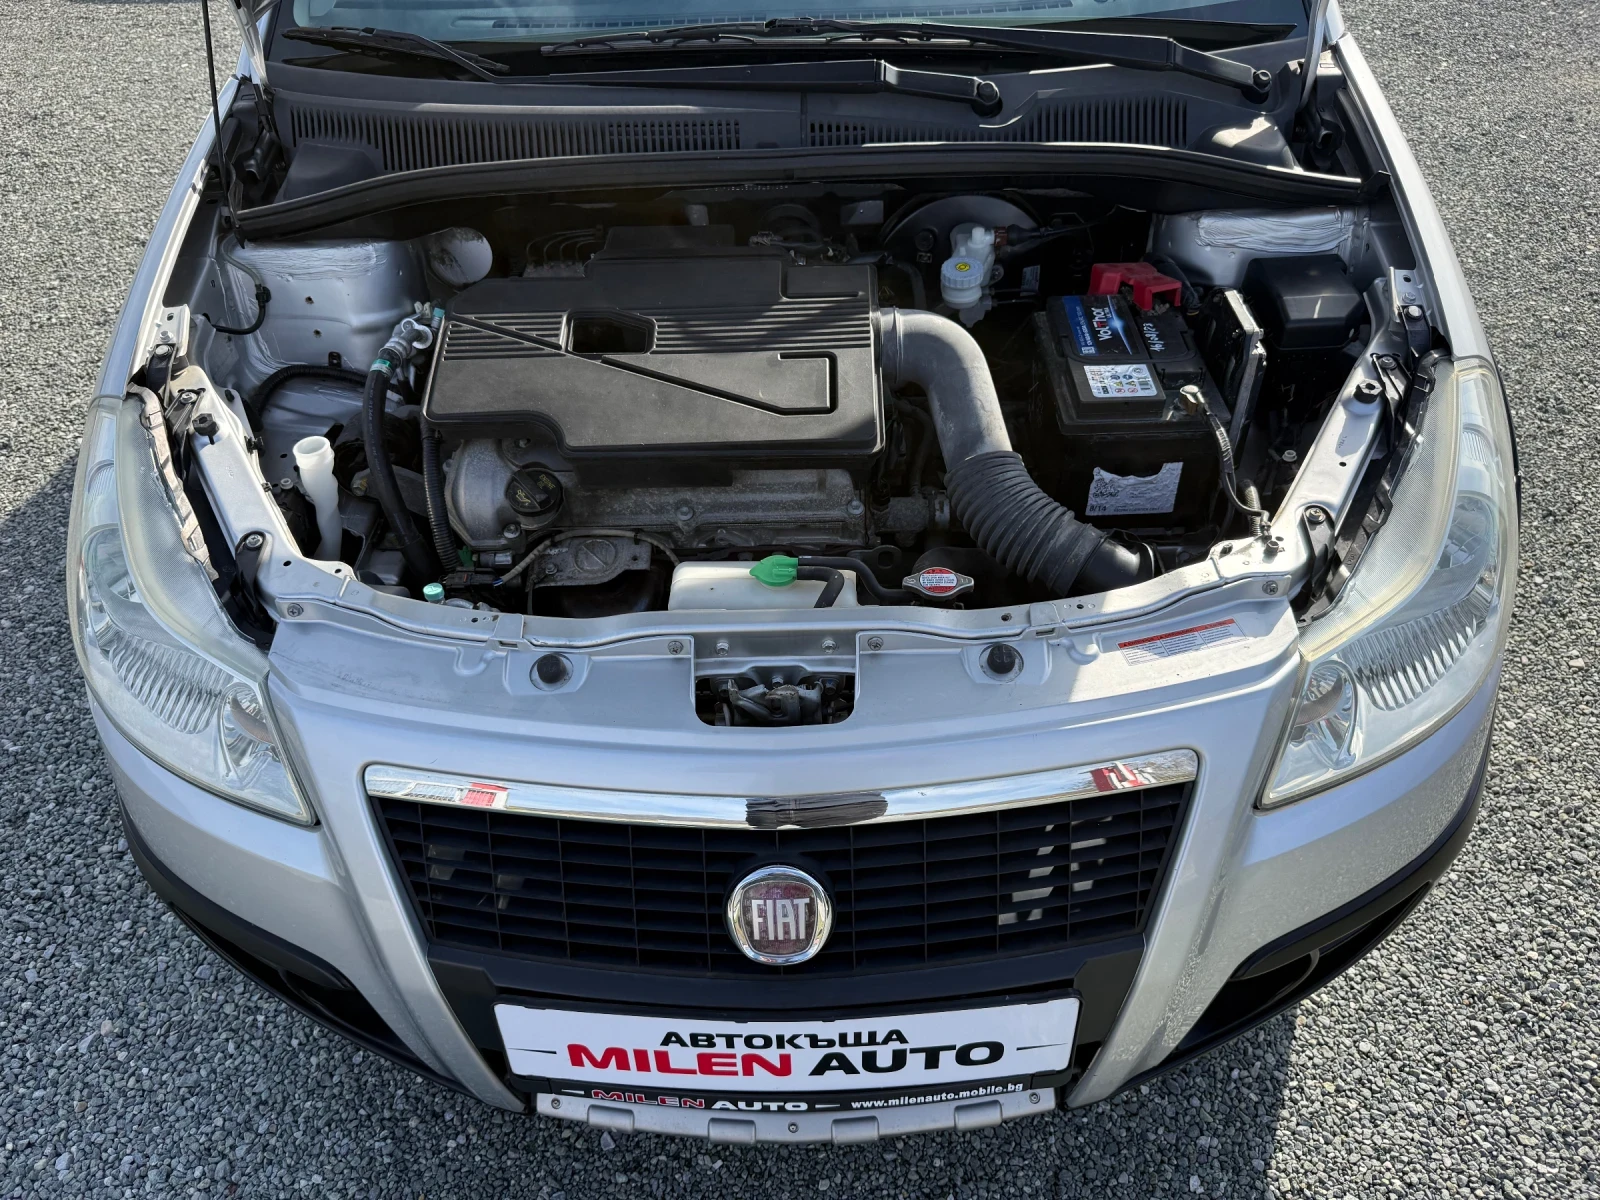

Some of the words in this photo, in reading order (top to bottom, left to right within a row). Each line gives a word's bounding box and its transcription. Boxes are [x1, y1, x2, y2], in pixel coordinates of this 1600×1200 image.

[1089, 504, 1107, 512] 8/14
[751, 897, 810, 941] FIAT
[659, 1028, 909, 1049] АВТОКЪЩА
[567, 1043, 792, 1077] MILEN
[808, 1041, 1004, 1076] AUTO
[591, 1089, 705, 1109] MILEN
[711, 1100, 808, 1111] AUTO
[851, 1083, 1023, 1109] www.milenauto.mobile.bg
